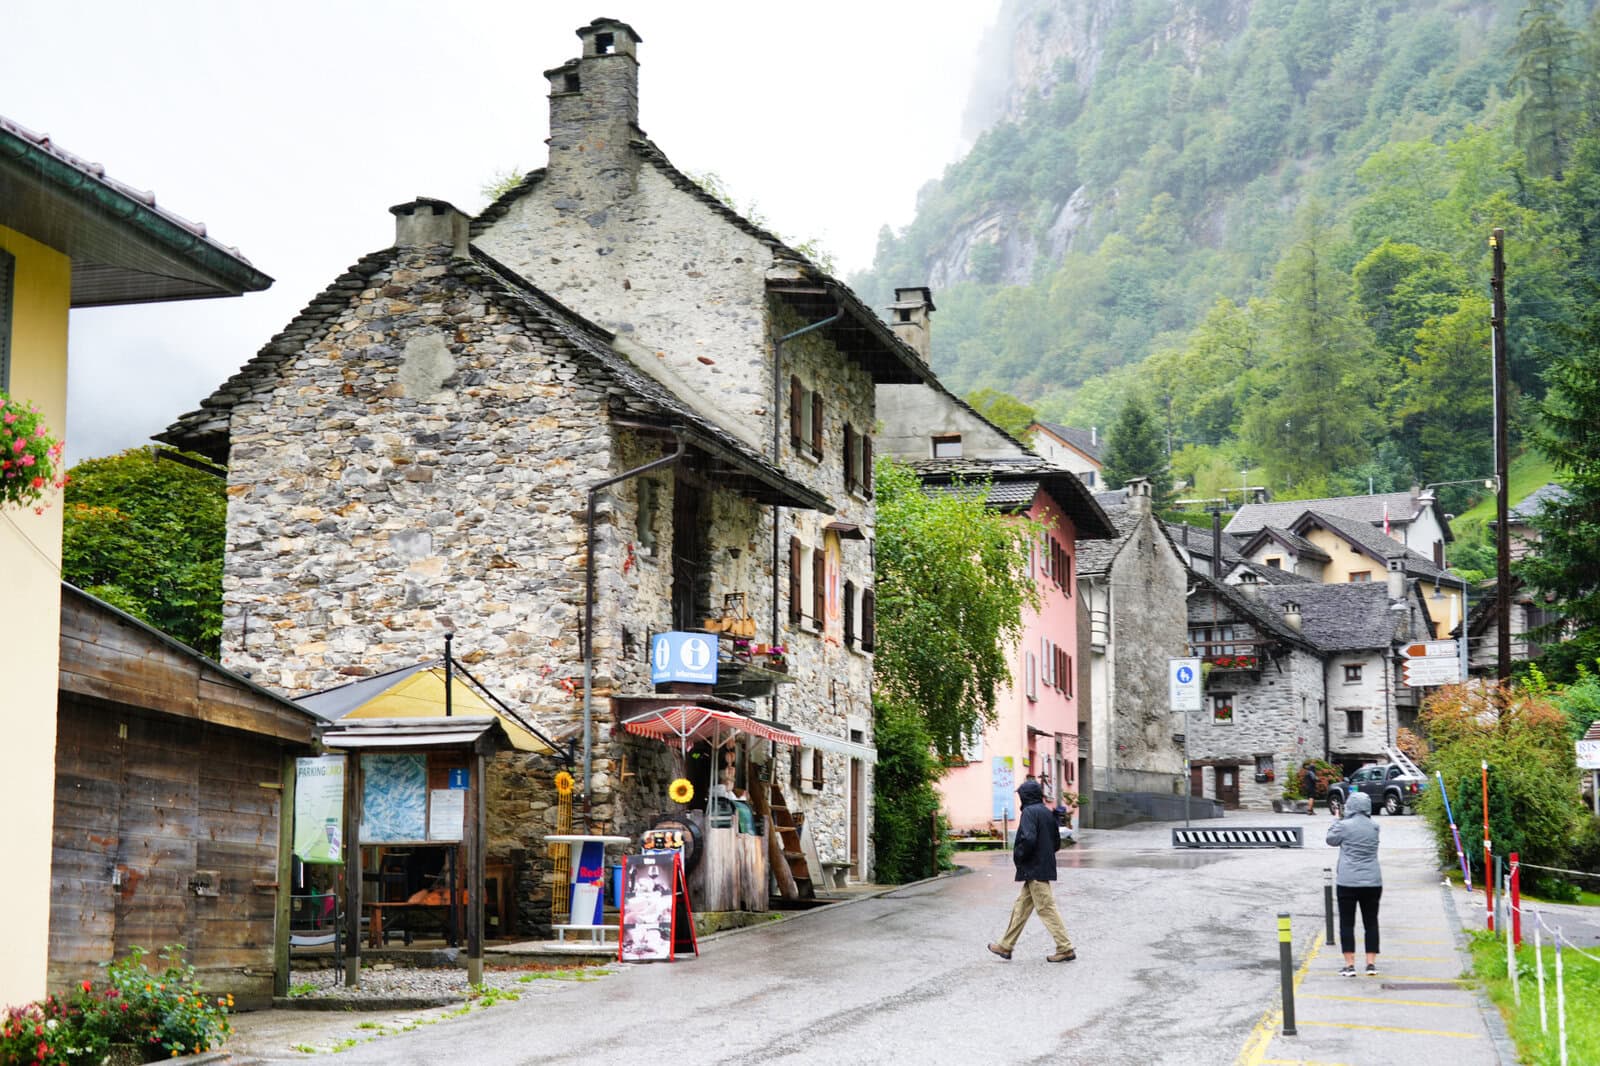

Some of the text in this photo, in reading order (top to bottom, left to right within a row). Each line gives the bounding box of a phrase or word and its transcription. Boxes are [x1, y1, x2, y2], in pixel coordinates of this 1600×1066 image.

[689, 639, 703, 667] i
[1579, 742, 1600, 753] RIS
[456, 769, 463, 786] i
